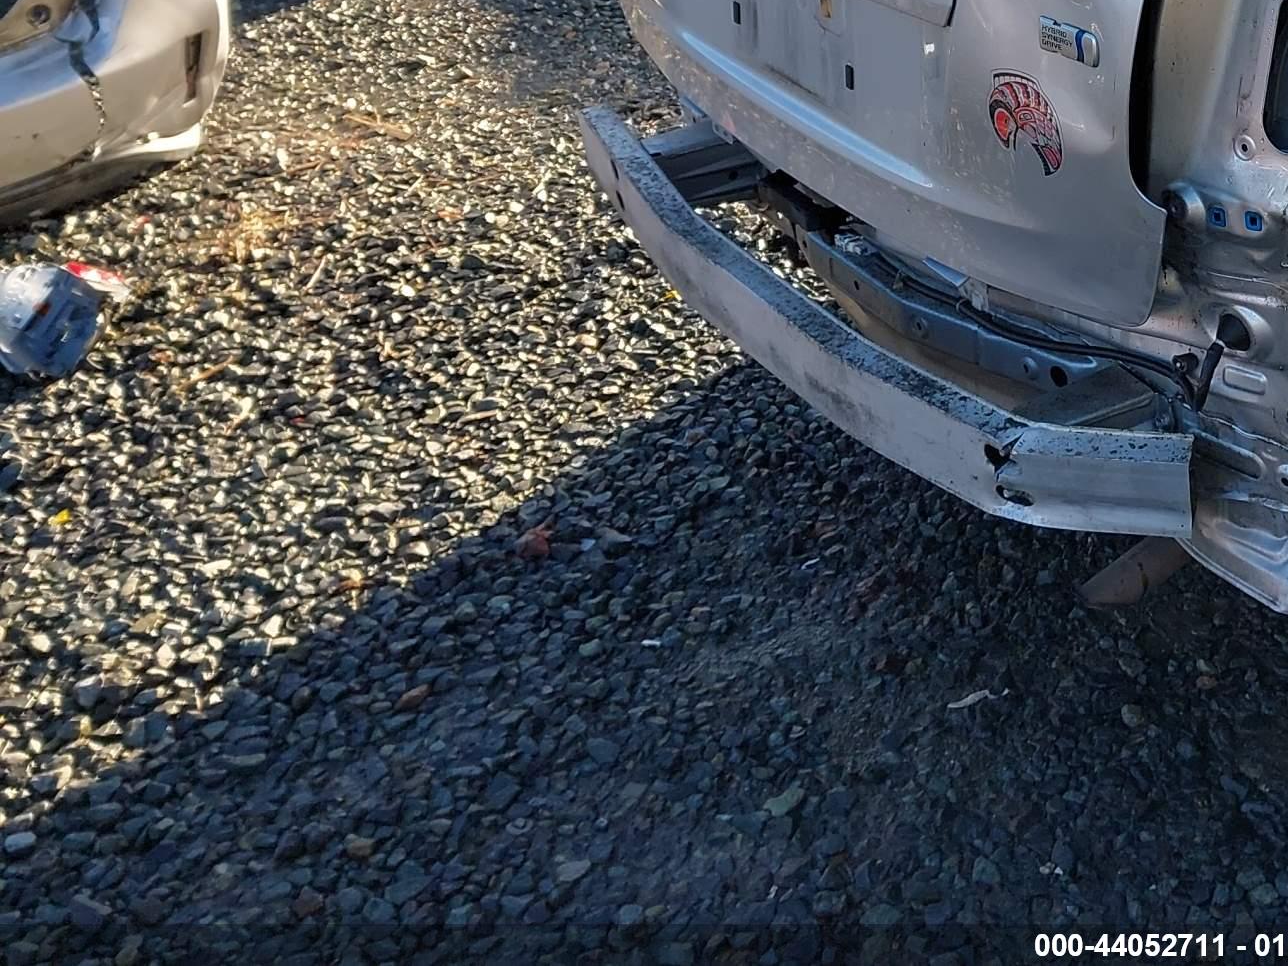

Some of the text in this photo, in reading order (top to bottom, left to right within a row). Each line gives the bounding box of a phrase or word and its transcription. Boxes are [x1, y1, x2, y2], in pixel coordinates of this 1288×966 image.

[1041, 23, 1068, 38] HYBRID
[1041, 31, 1073, 47] SYNERGY
[1041, 38, 1063, 51] DRIVE
